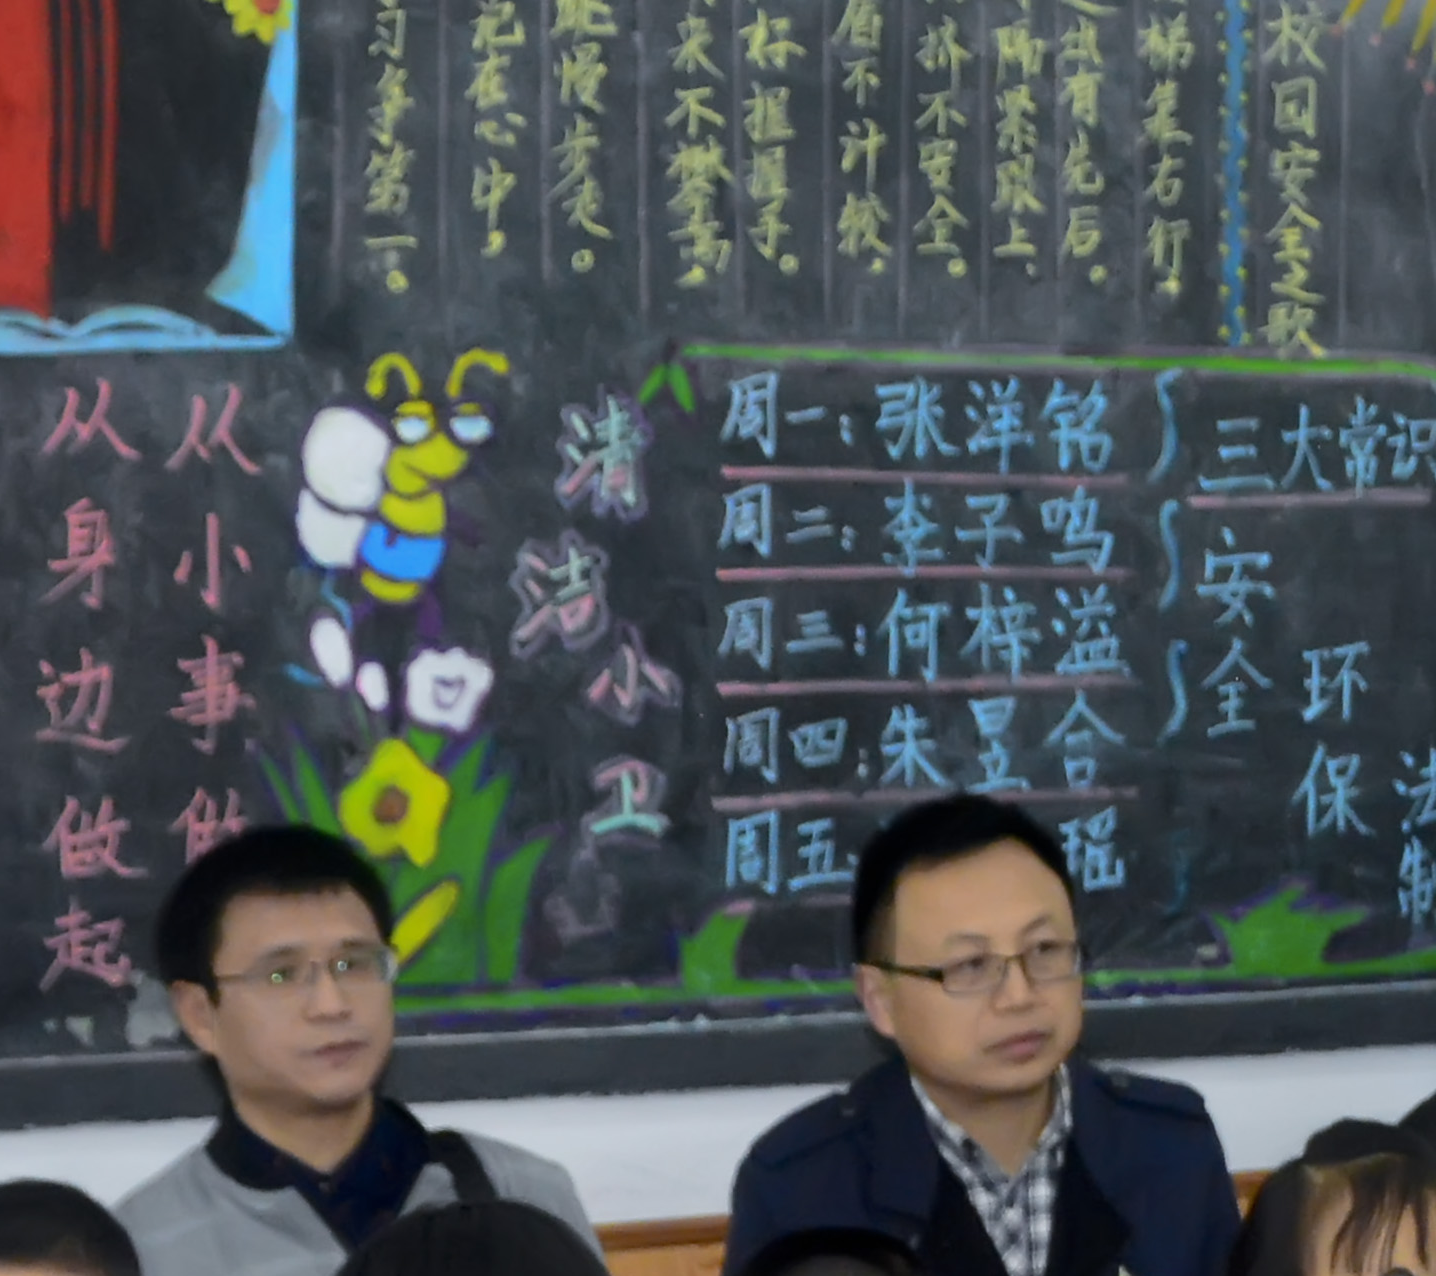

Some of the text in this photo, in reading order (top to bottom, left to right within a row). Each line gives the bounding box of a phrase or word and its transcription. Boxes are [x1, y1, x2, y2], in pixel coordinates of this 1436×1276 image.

[34, 378, 149, 992] 从身边做起
[1197, 526, 1277, 738] 安全
[1291, 640, 1374, 838] 环保
